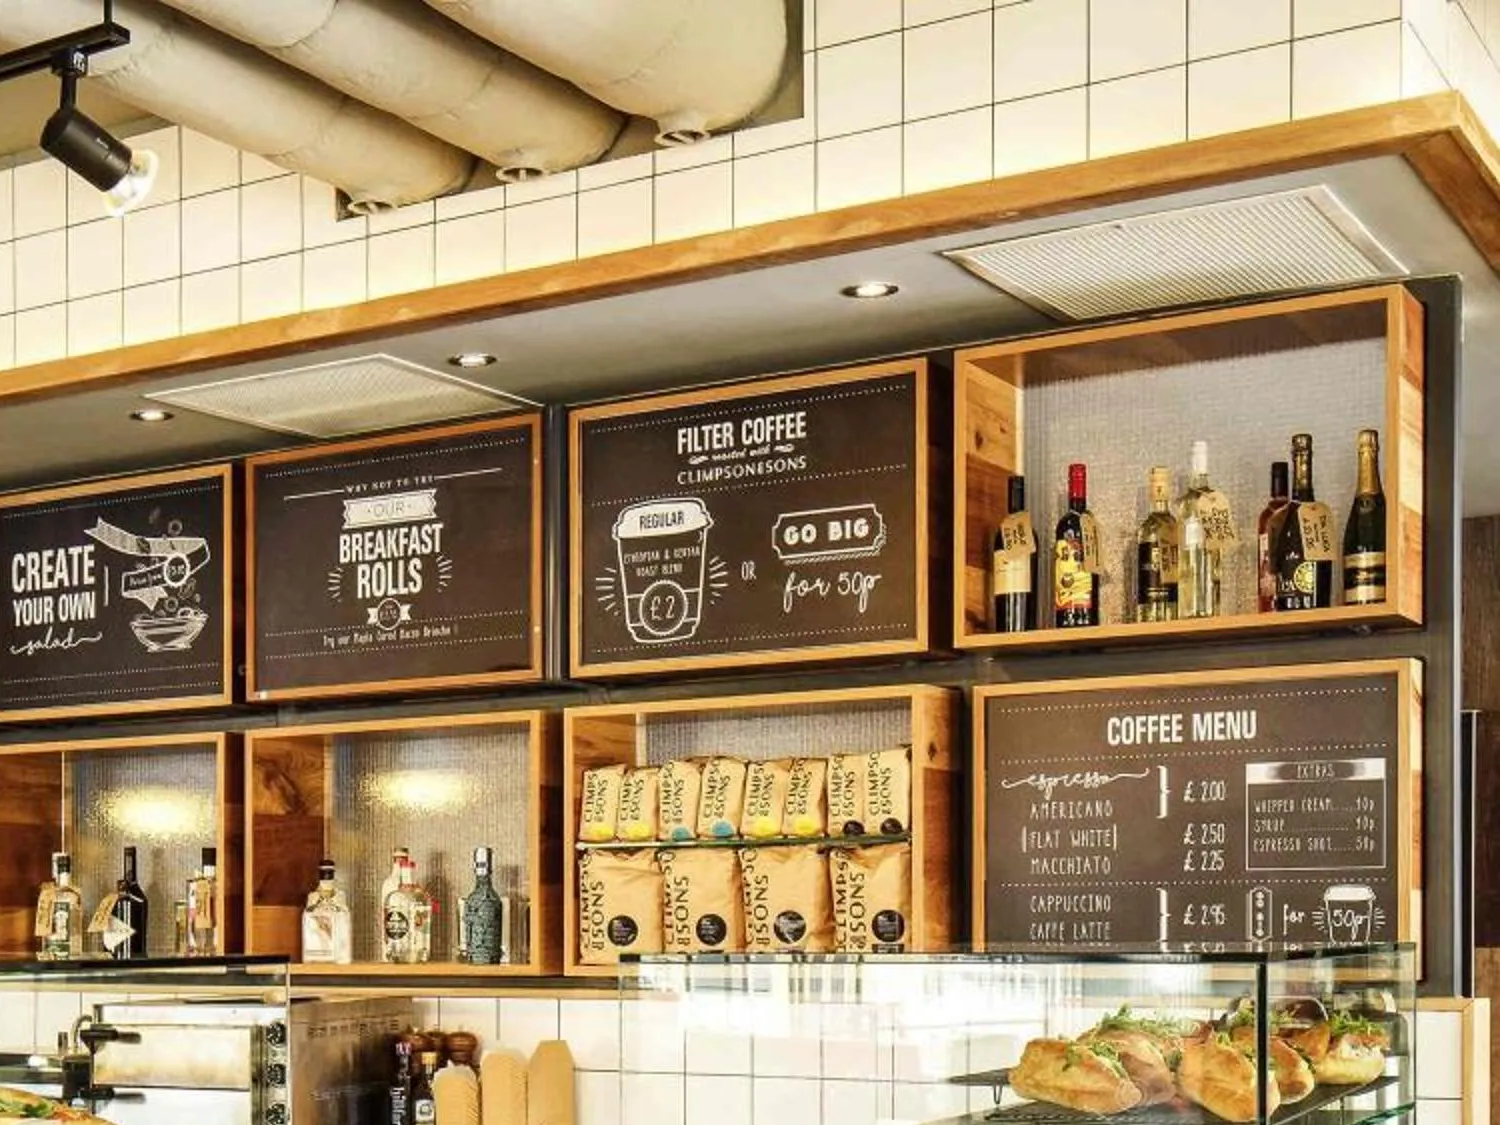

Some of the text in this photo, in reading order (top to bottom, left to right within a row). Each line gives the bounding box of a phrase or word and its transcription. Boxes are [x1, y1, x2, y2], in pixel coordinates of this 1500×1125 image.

[677, 411, 807, 455] FILTER COFFEE
[639, 511, 685, 529] REGULAR
[783, 517, 869, 545] GO BIG
[339, 522, 444, 564] BREAKFAST
[11, 543, 95, 593] CREATE
[357, 557, 423, 600] ROLLS
[741, 561, 756, 582] OR
[12, 591, 96, 627] YOUR OWN
[650, 595, 675, 621] £2
[783, 571, 882, 613] for 50p
[11, 626, 101, 655] salad
[1107, 710, 1257, 746] COFFEE MENU
[583, 772, 599, 823] CLIMPS
[703, 759, 721, 818] CLIMPSO
[830, 755, 845, 817] CLIMPSO
[867, 750, 881, 816] CLIMPSO
[1029, 800, 1113, 820] AMERICANO
[1029, 830, 1060, 850] FLAT
[1070, 827, 1112, 848] WHITE
[1029, 856, 1112, 875] MACCHIATO
[1029, 894, 1112, 913] CAPPUCCINO
